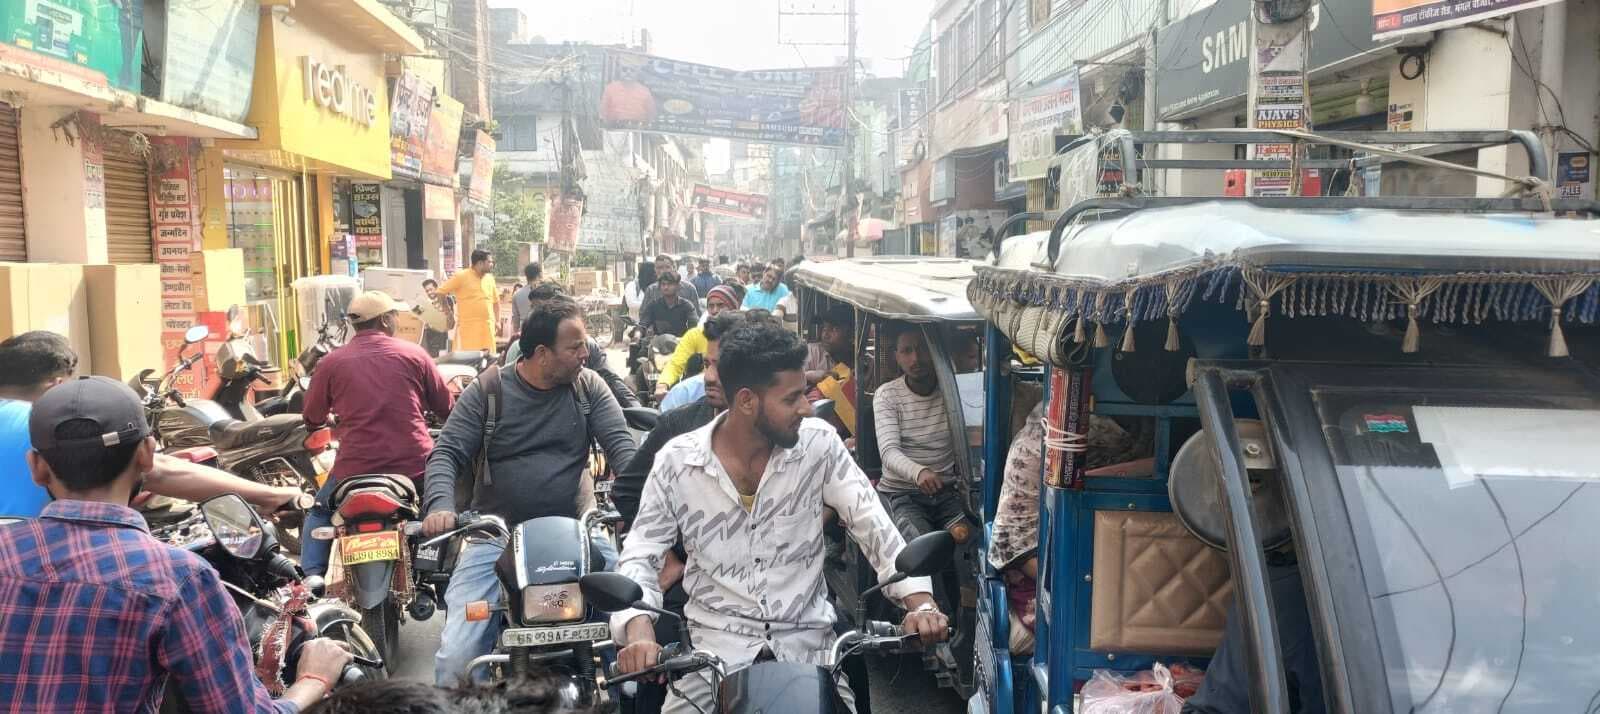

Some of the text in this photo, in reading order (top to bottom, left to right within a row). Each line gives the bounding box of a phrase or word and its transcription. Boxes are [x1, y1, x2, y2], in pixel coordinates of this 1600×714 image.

[299, 56, 377, 130] realme
[1257, 109, 1300, 121] AJAY'S
[160, 228, 188, 238] जन्मदिन
[161, 247, 188, 256] उपनयन
